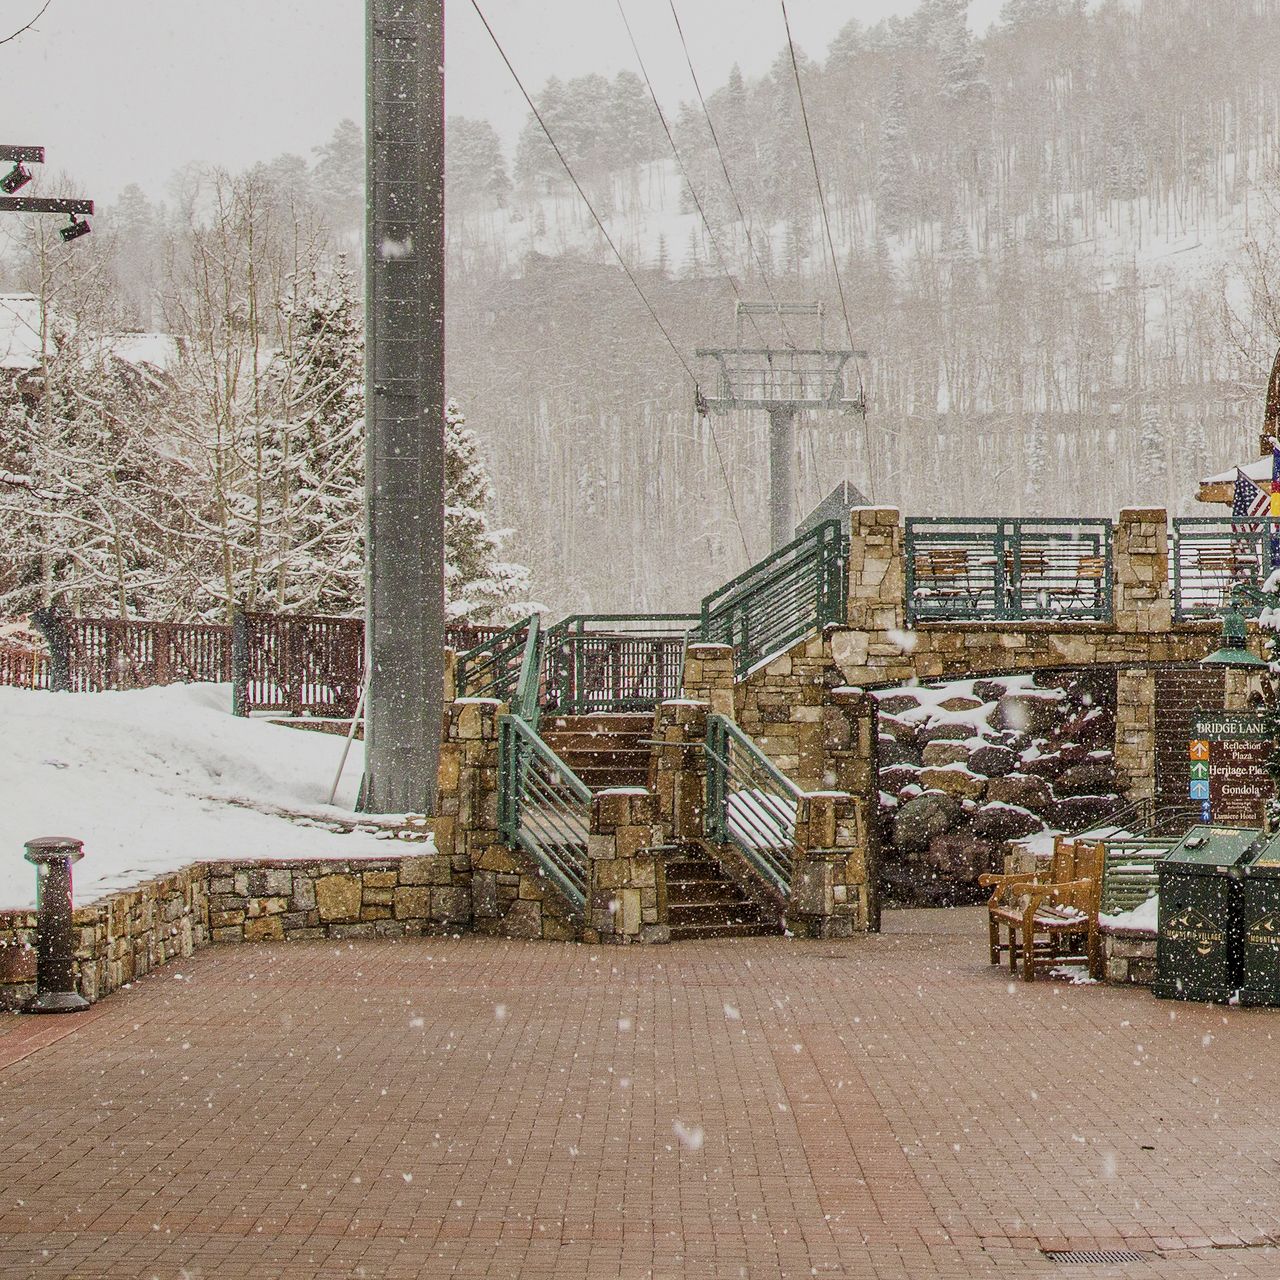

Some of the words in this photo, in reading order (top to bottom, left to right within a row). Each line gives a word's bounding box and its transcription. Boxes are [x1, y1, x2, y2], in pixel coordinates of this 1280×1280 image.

[1197, 723, 1237, 734] BRIDGE
[1239, 723, 1267, 734] LANE
[1223, 741, 1261, 750] Reflection
[1232, 752, 1253, 760] Plaza
[1209, 765, 1247, 777] Heritage
[1221, 785, 1260, 795] Gondola
[1240, 811, 1257, 820] Hotel
[1198, 930, 1222, 941] VILLAGE
[1249, 934, 1280, 944] MOUNTAIN
